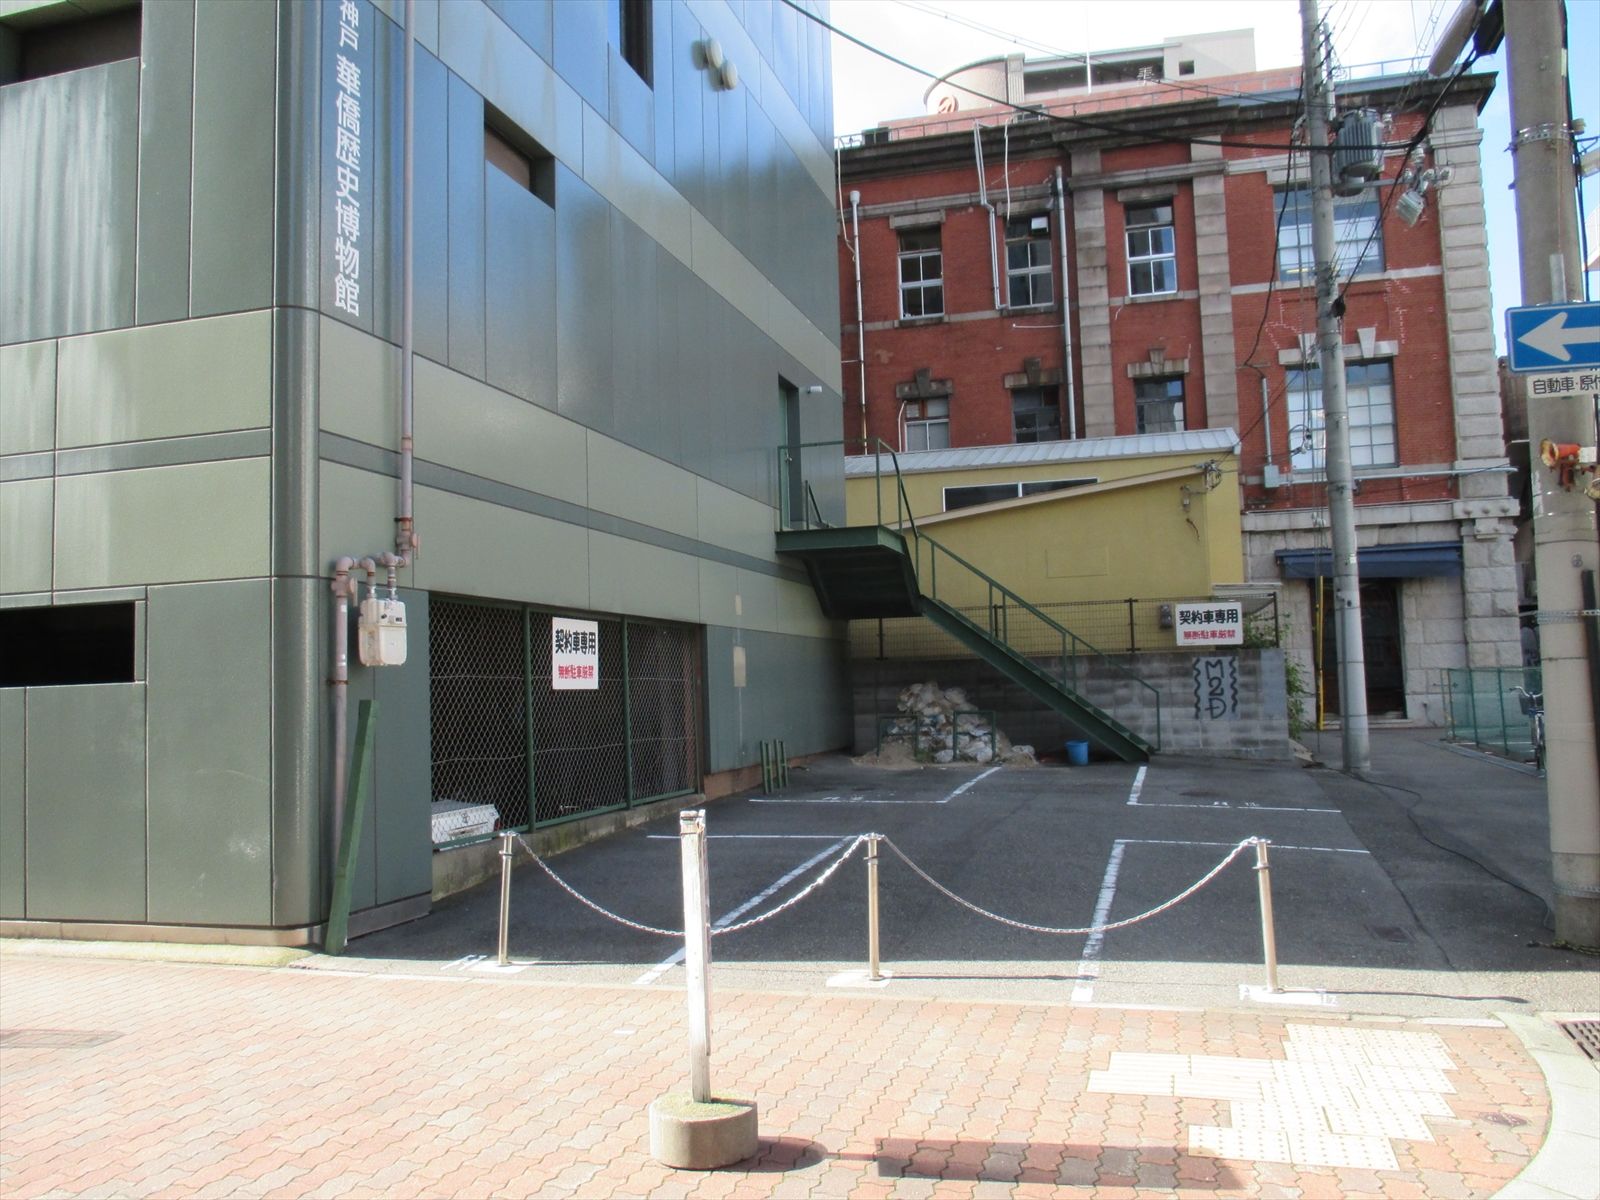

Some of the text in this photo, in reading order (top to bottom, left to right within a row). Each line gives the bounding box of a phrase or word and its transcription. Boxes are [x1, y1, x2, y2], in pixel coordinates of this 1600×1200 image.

[335, 0, 361, 317] 神戸 華僑歴史博物館
[1179, 608, 1239, 625] 契約車専用
[555, 629, 596, 655] 契約車専用
